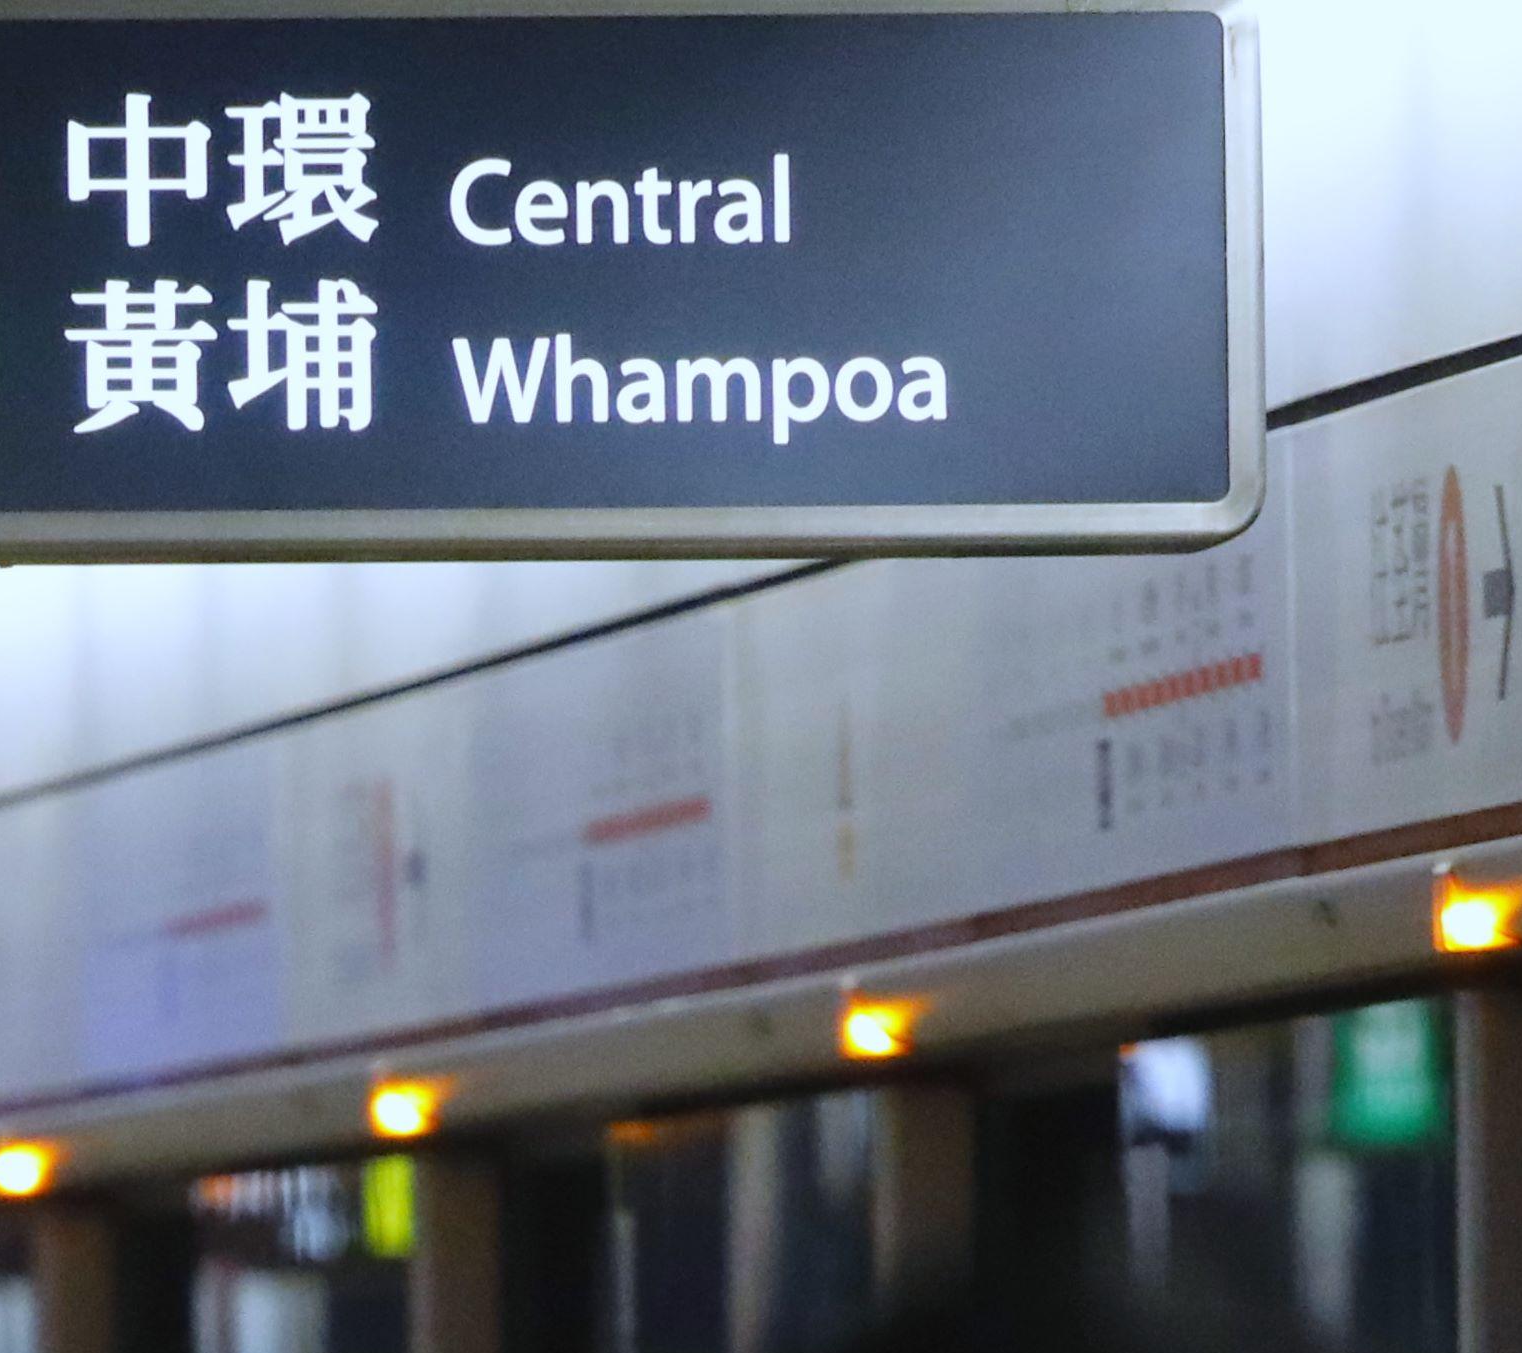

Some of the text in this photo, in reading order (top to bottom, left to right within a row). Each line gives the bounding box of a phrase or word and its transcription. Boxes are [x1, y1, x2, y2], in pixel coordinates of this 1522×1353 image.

[66, 91, 380, 248] 中環
[449, 152, 792, 247] Central
[64, 278, 379, 435] 黃埔
[452, 332, 949, 446] Whampoa
